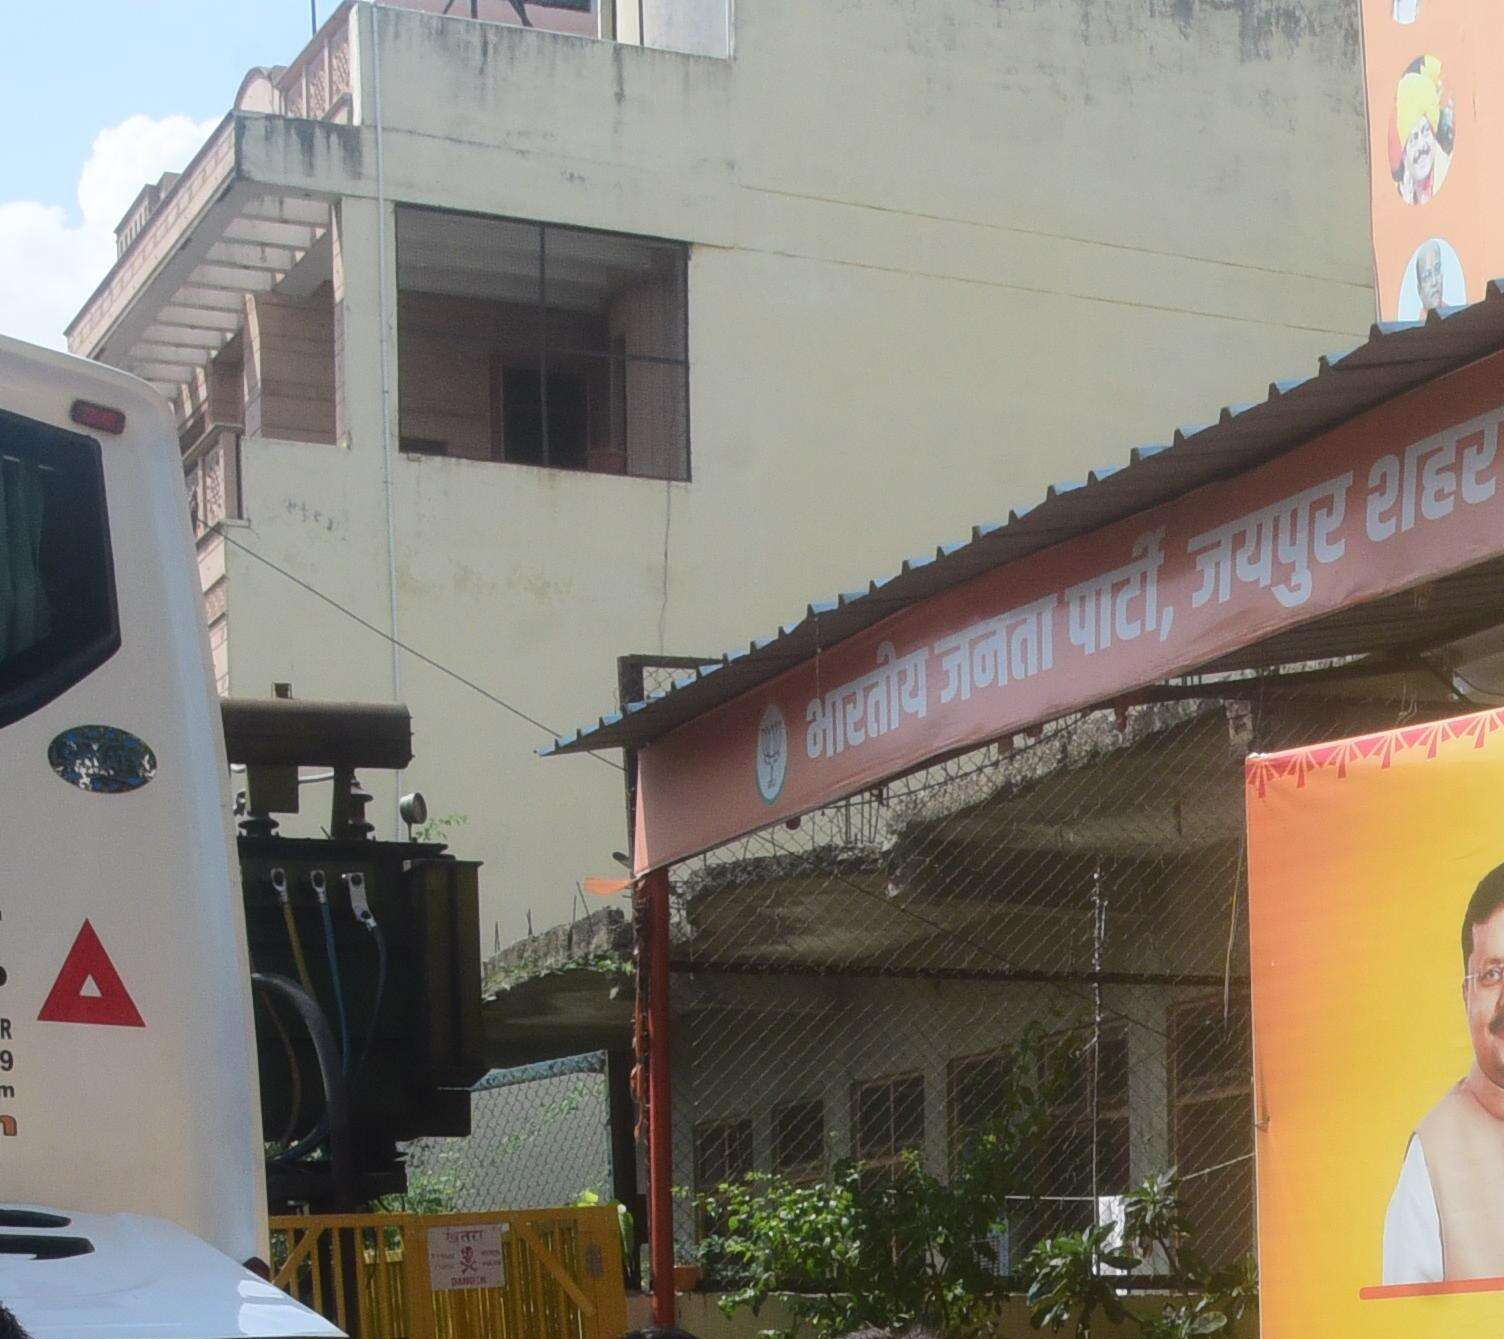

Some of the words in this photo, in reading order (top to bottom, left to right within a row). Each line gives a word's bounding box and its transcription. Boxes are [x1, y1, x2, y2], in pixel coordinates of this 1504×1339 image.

[805, 641, 930, 759] भारतीय
[934, 593, 1058, 704] जनता
[1065, 525, 1174, 655] पार्टी,
[1188, 470, 1353, 608] जयपुर
